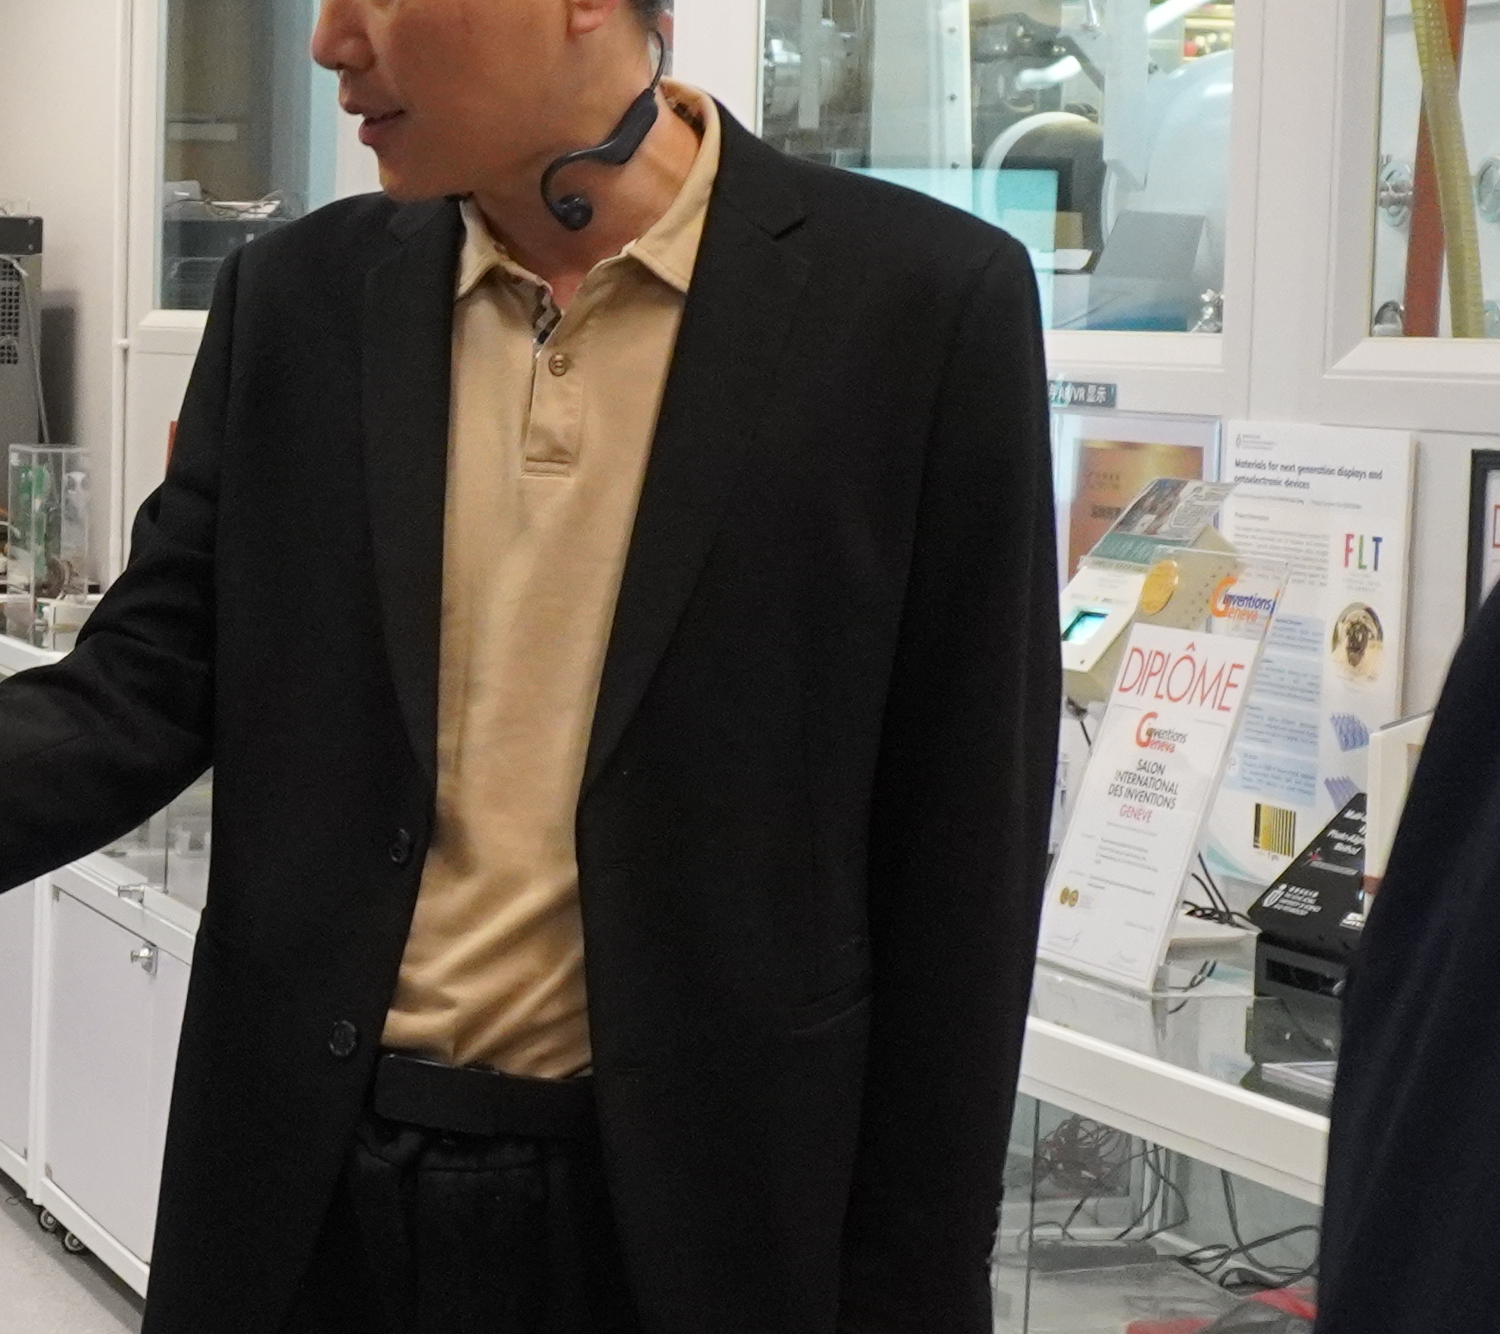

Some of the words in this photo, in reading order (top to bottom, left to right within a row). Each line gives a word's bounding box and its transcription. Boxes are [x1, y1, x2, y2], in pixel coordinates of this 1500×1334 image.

[1268, 461, 1279, 471] for
[1280, 463, 1296, 473] next
[1297, 464, 1336, 477] generation
[1337, 466, 1367, 481] displays
[1368, 469, 1384, 480] and
[1284, 478, 1311, 490] devices
[1343, 533, 1384, 572] FLT
[1118, 642, 1245, 712] DIPLÔME
[1136, 759, 1166, 775] SALON
[1114, 770, 1179, 795] INTERNATIONAL
[1108, 784, 1124, 798] DES
[1124, 787, 1177, 810] INVENTIONS
